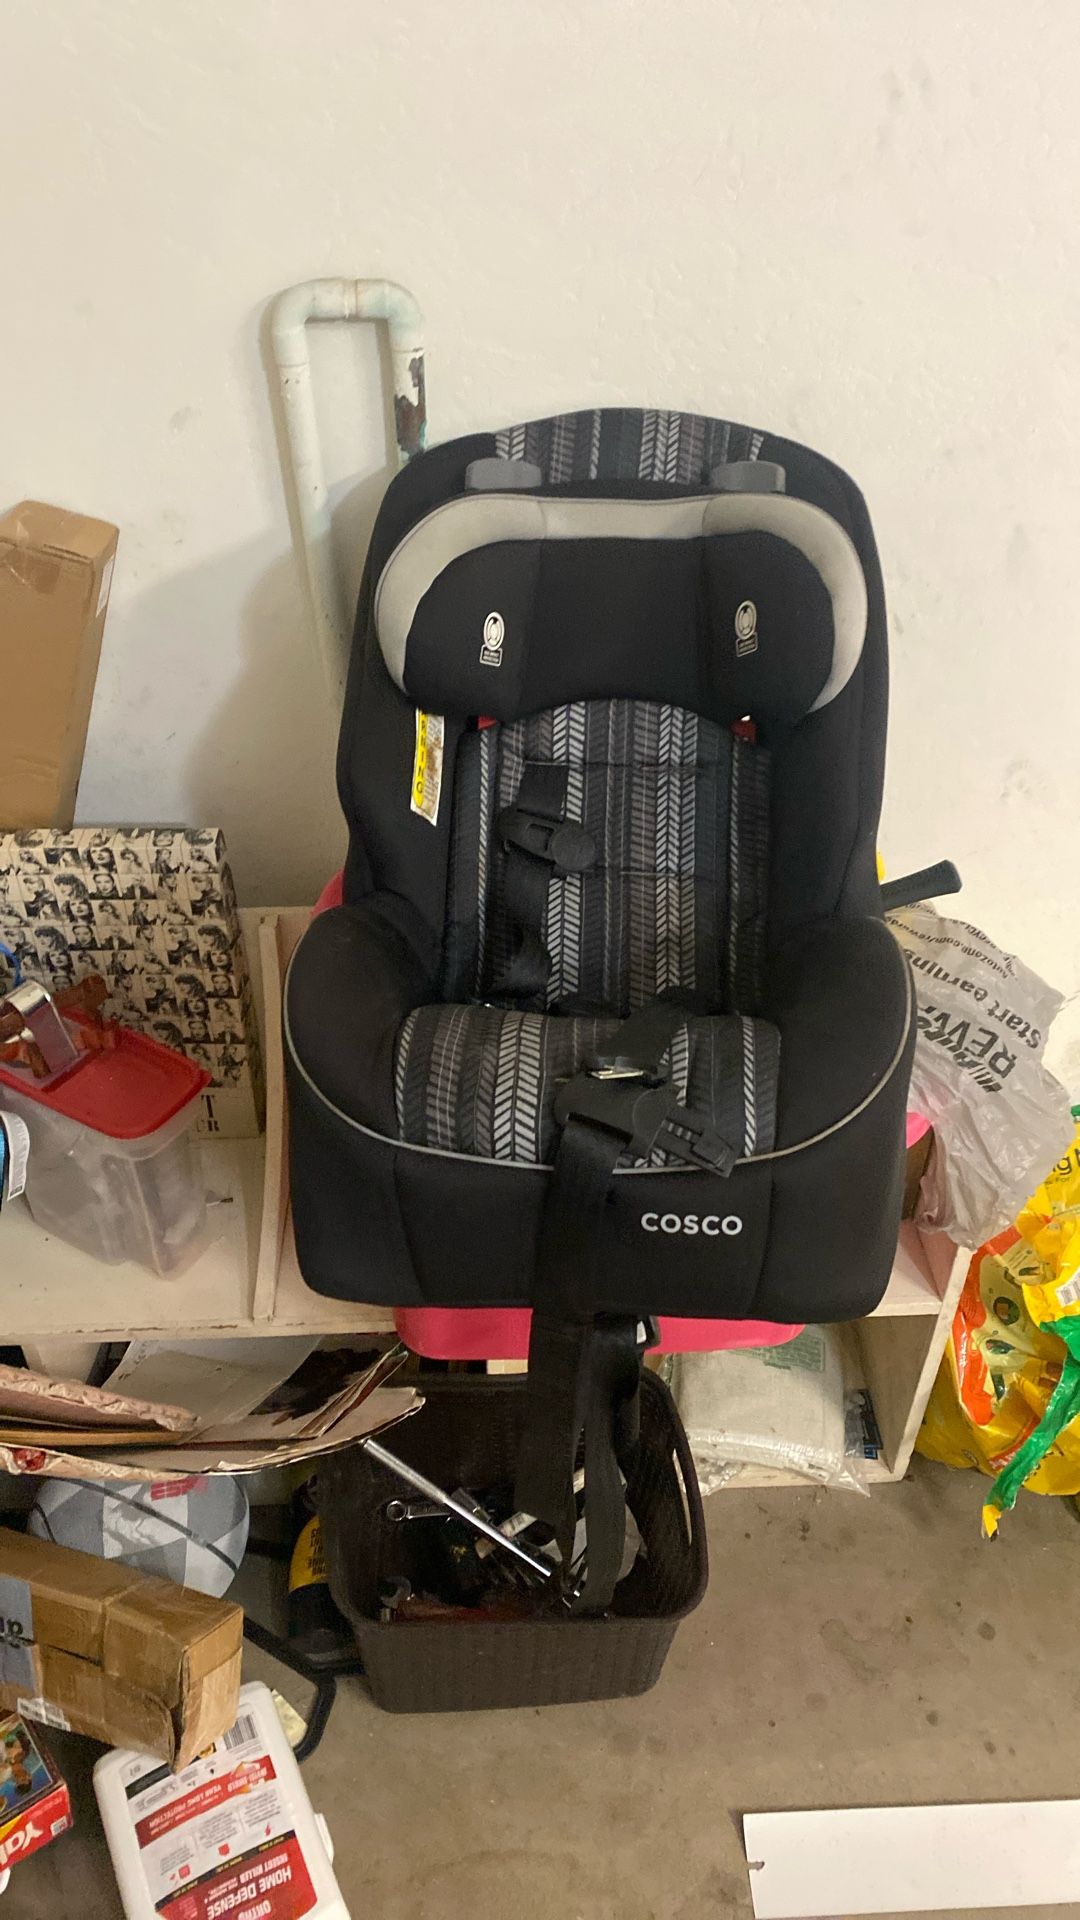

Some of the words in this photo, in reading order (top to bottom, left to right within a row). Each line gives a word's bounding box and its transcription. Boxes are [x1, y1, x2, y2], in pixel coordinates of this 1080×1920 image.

[416, 711, 428, 793] RNING
[986, 999, 1042, 1050] Start
[641, 1212, 743, 1236] COSCO
[258, 1864, 292, 1893] HOME
[206, 1886, 257, 1920] DEFENSE
